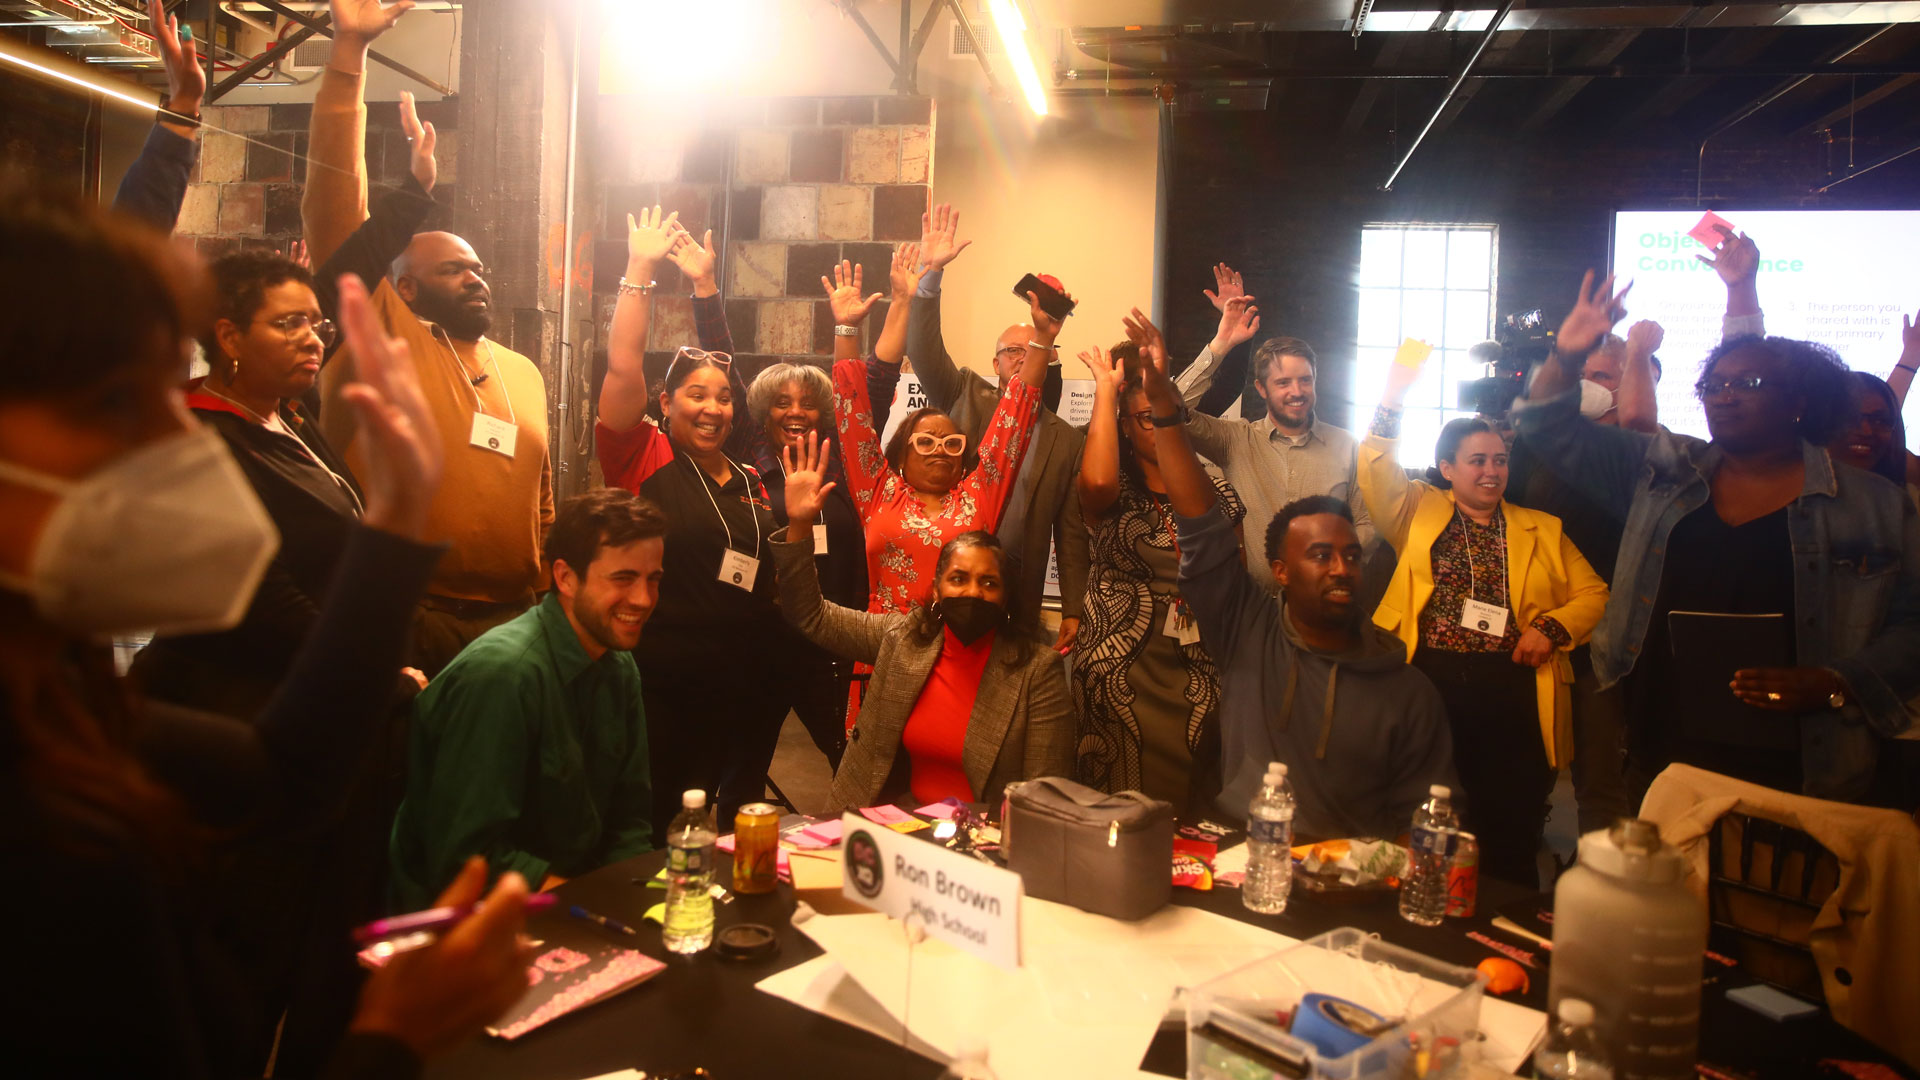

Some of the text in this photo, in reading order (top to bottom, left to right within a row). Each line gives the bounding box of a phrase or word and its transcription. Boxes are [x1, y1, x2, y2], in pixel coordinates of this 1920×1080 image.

[1808, 302, 1829, 312] The
[1831, 303, 1874, 315] person
[1878, 304, 1901, 314] you
[1806, 316, 1891, 326] shared with is
[1835, 329, 1885, 341] primary
[894, 853, 930, 889] Ron
[935, 870, 1001, 917] Brown
[910, 898, 987, 946] High School
